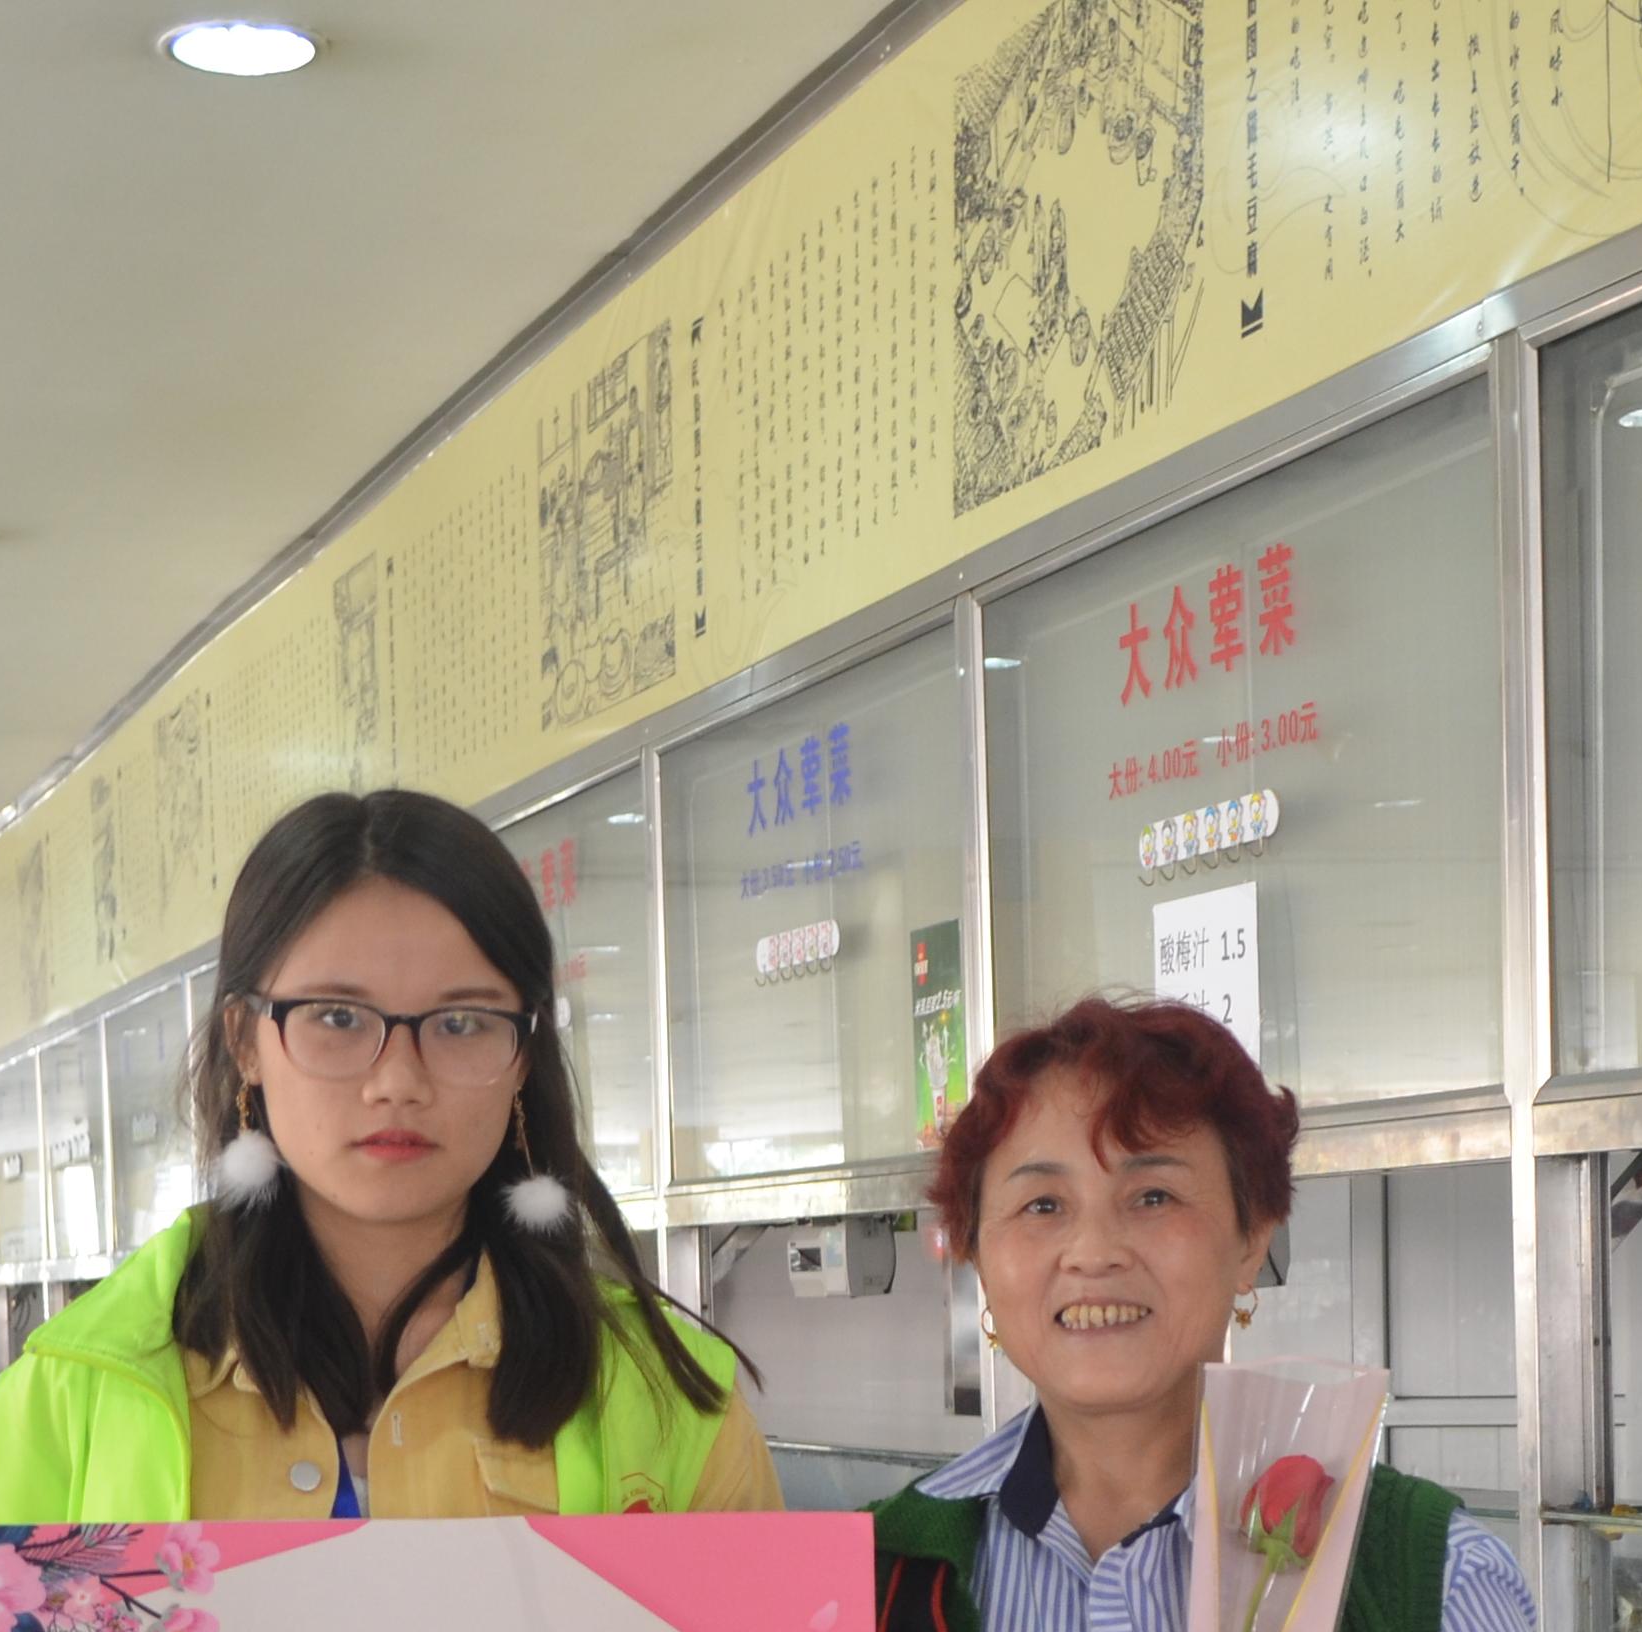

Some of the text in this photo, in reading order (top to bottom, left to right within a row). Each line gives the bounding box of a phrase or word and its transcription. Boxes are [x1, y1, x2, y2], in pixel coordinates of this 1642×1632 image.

[1119, 542, 1296, 706] 大众荤菜
[746, 722, 852, 837] 大众荤菜
[1160, 927, 1246, 976] 酸梅汁 1.5
[1222, 993, 1233, 1024] 2
